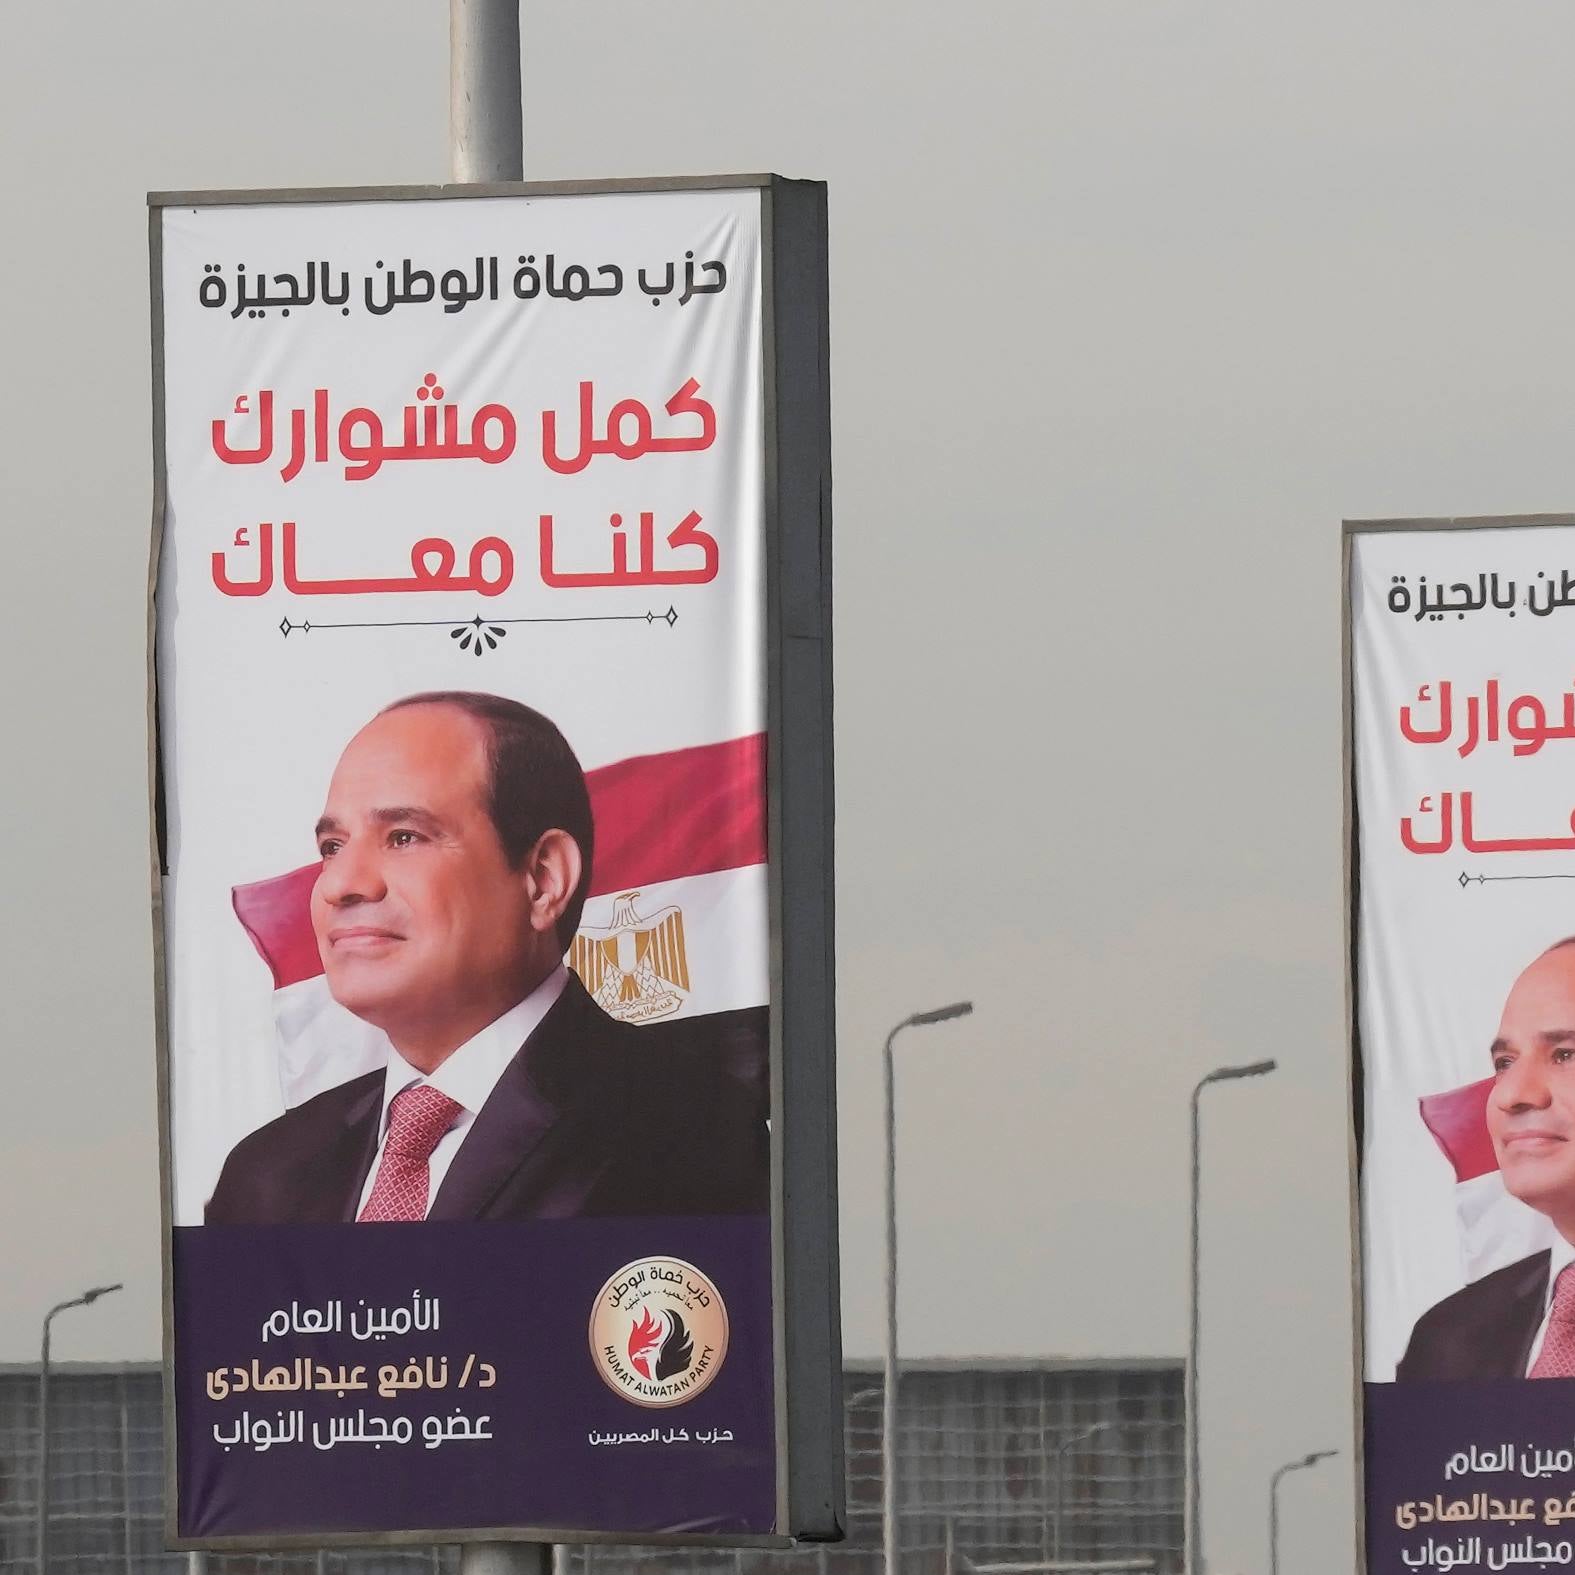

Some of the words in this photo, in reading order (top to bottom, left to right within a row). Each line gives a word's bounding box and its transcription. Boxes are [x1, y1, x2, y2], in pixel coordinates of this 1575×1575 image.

[200, 262, 349, 319] بالجيزة
[365, 257, 498, 315] الوطن
[514, 255, 623, 301] حماة
[638, 251, 726, 306] حزب
[212, 373, 516, 483] مشوارك
[542, 378, 716, 474] كمل
[212, 523, 513, 596] معاك
[540, 510, 719, 588] كلنا
[1388, 573, 1516, 622] بالجيزة
[263, 1301, 341, 1342] العام
[351, 1289, 439, 1340] الأمين
[378, 1357, 447, 1397] نافع
[604, 1345, 634, 1386] HUMAT
[634, 1381, 690, 1397] ALWATAN
[690, 1345, 715, 1383] PARTY
[214, 1411, 303, 1451] النواب
[313, 1409, 412, 1450] مجلس
[422, 1408, 492, 1448] عضو
[589, 1429, 658, 1445] المصريين
[662, 1429, 689, 1443] كل
[696, 1428, 733, 1443] حزب
[1445, 1445, 1512, 1480] العام
[1404, 1538, 1480, 1572] النواب
[1488, 1535, 1573, 1570] مجلس
